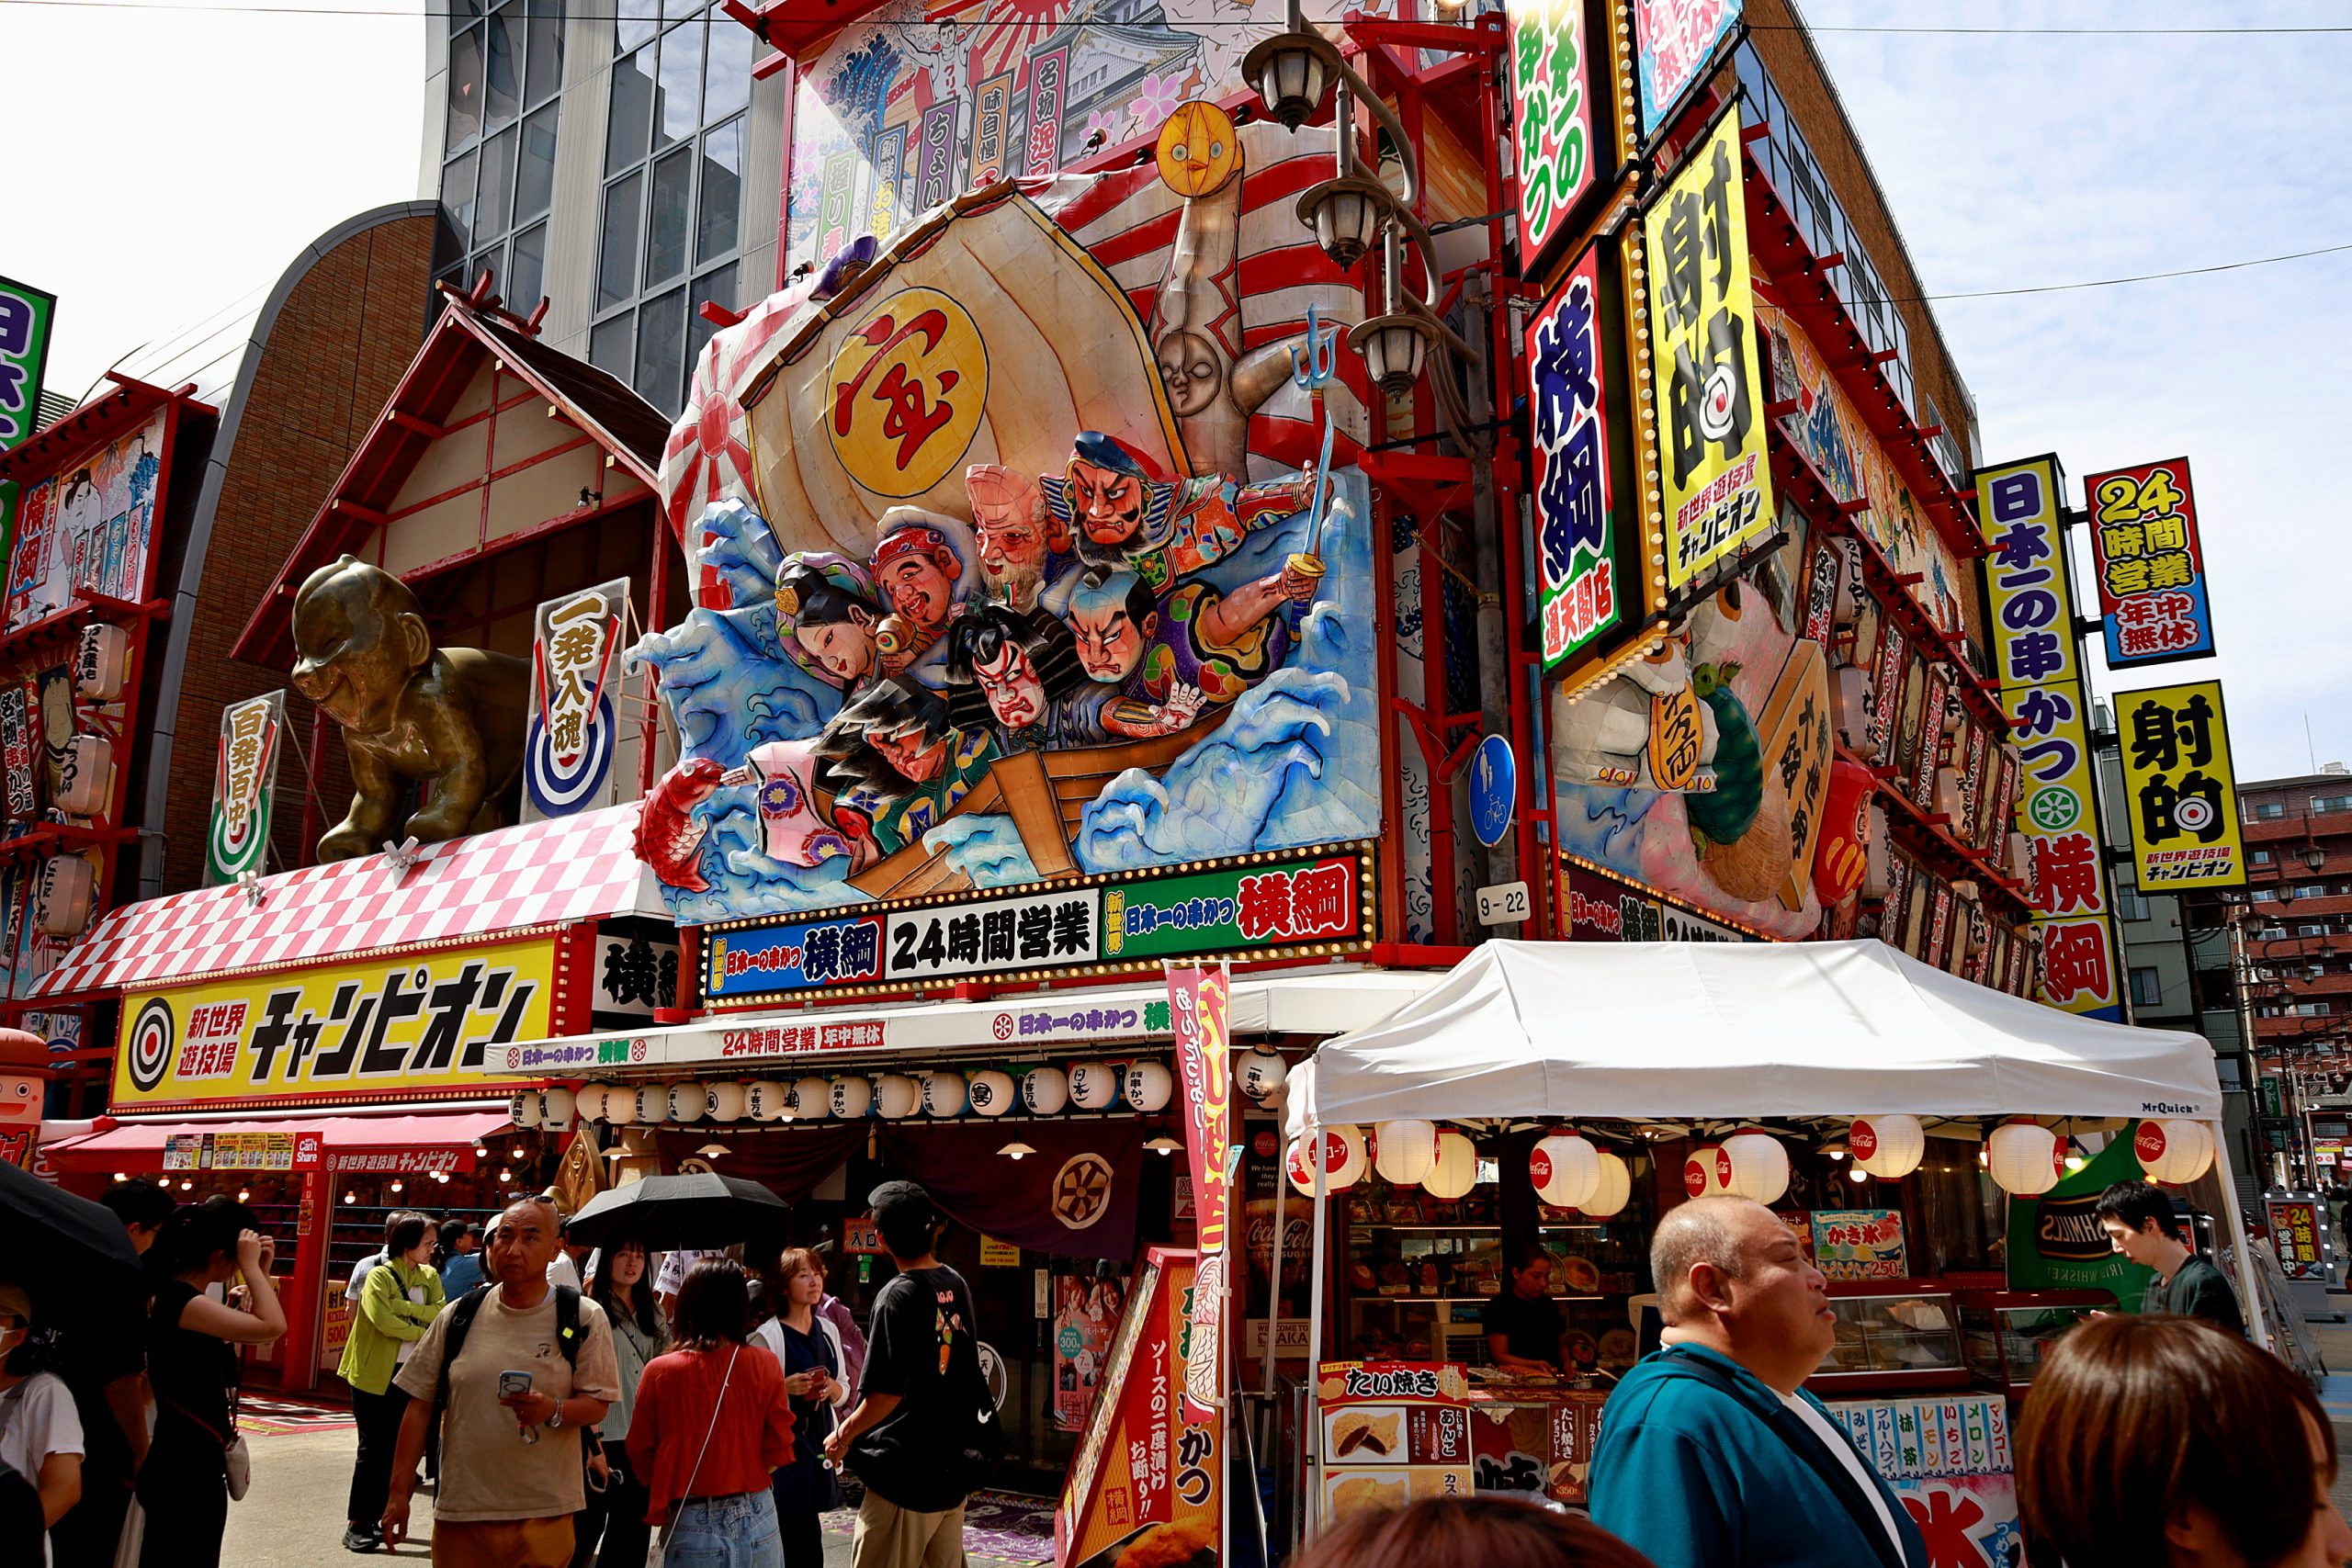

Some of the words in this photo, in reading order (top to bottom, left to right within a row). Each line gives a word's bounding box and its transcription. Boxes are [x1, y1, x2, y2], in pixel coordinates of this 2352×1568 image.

[1661, 140, 1752, 491] 射的
[835, 309, 959, 470] 宝
[1533, 275, 1602, 590] 横綱
[15, 481, 50, 591] 横綱
[1679, 489, 1760, 570] チャンピオン
[1544, 558, 1612, 660] 通天閣店
[1990, 471, 2080, 780] 日本一の串かつ
[551, 594, 607, 753] 一発入魂
[228, 701, 269, 830] 百発百中
[2131, 694, 2225, 845] 射的
[2144, 846, 2231, 865] 新世界遊技場
[2146, 862, 2233, 881] チャンピオン
[1106, 891, 1124, 954] 新世界
[1125, 897, 1234, 935] 日本一の串かつ
[1237, 864, 1348, 940] 横綱
[1480, 889, 1525, 917] 9-22
[2030, 831, 2112, 1005] 横綱
[726, 947, 801, 976] 日本一の串かつ
[803, 922, 878, 981] 横綱
[891, 900, 1091, 970] 24時間営業
[187, 1003, 244, 1039] 新世界
[251, 964, 534, 1080] チャンピオン
[723, 1026, 816, 1056] 24時間営業
[824, 1023, 882, 1047] 年中無休
[1018, 1010, 1137, 1035] 日本一の串かつ
[1144, 1003, 1173, 1032] 横
[176, 1042, 238, 1077] 遊技場
[522, 1045, 594, 1066] 日本一の串かつ
[598, 1040, 630, 1064] 横綱
[833, 1090, 846, 1115] 串かつ
[1072, 1068, 1091, 1102] 日本一
[1130, 1078, 1144, 1107] 串かつ
[2142, 1102, 2193, 1113] MrQuick
[297, 1152, 318, 1164] Share
[337, 1155, 398, 1171] 新世界遊技場
[399, 1151, 459, 1171] チャンピオン
[1826, 1224, 1882, 1247] かき氷
[1257, 1324, 1296, 1332] WECOME
[1345, 1368, 1438, 1396] たい焼き
[1150, 1339, 1167, 1490] ソースの二度漬け
[1440, 1409, 1456, 1457] あんこ
[1561, 1406, 1574, 1459] たい焼き
[1852, 1412, 1869, 1450] みぞ
[1875, 1407, 1894, 1472] ブルーハワイ
[1899, 1414, 1918, 1467] 抹茶
[1921, 1406, 1939, 1467] レモン
[1944, 1405, 1962, 1466] いちご
[1967, 1404, 1984, 1465] メロン
[1989, 1403, 2007, 1464] マンゴー
[1106, 1489, 1129, 1524] 横綱
[1130, 1440, 1152, 1520] お断り!!
[1444, 1473, 1457, 1498] カス
